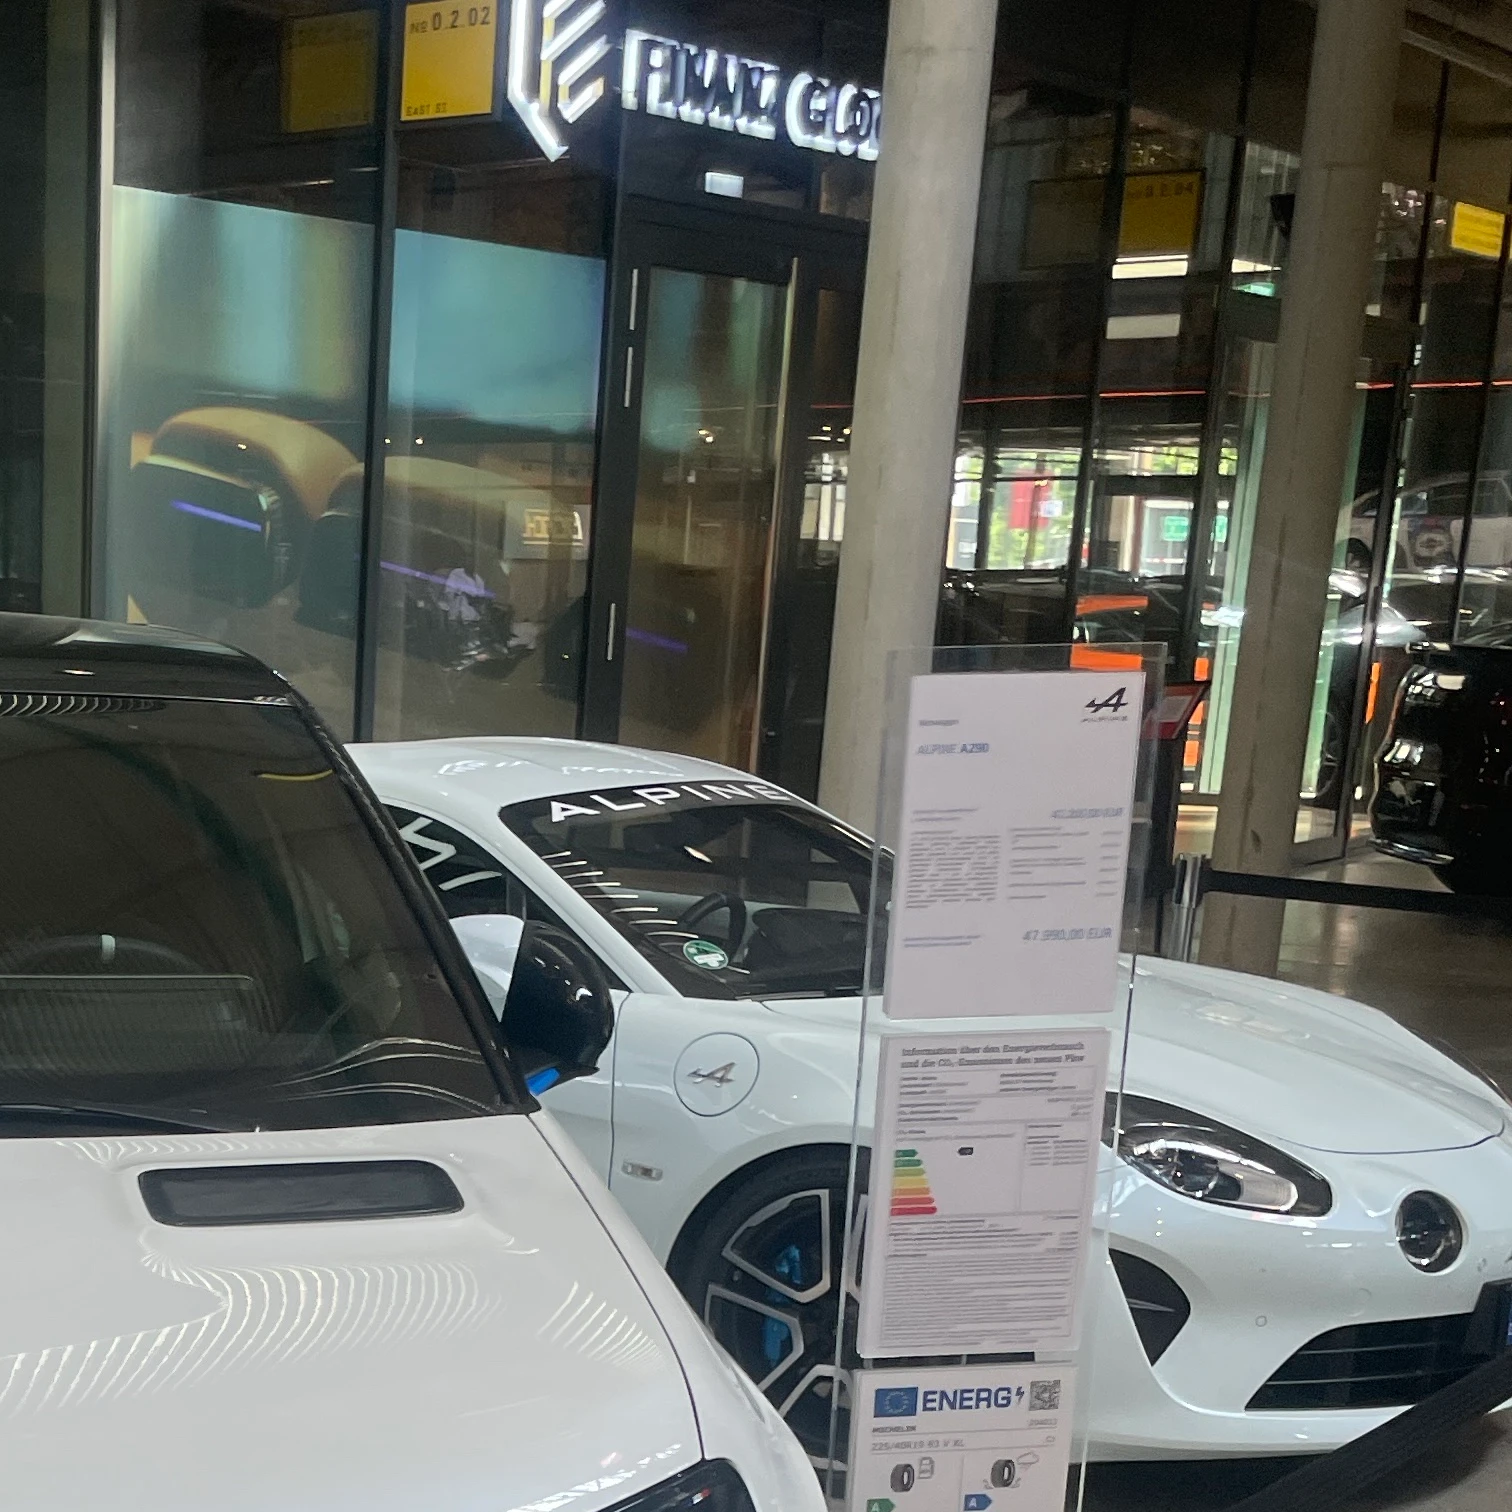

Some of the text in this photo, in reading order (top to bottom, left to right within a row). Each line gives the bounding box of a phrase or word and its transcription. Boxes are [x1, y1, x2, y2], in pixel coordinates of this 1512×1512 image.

[550, 783, 791, 823] ALPINE
[922, 1386, 1012, 1411] ENERG
[871, 1502, 880, 1512] A
[969, 1497, 978, 1508] A
